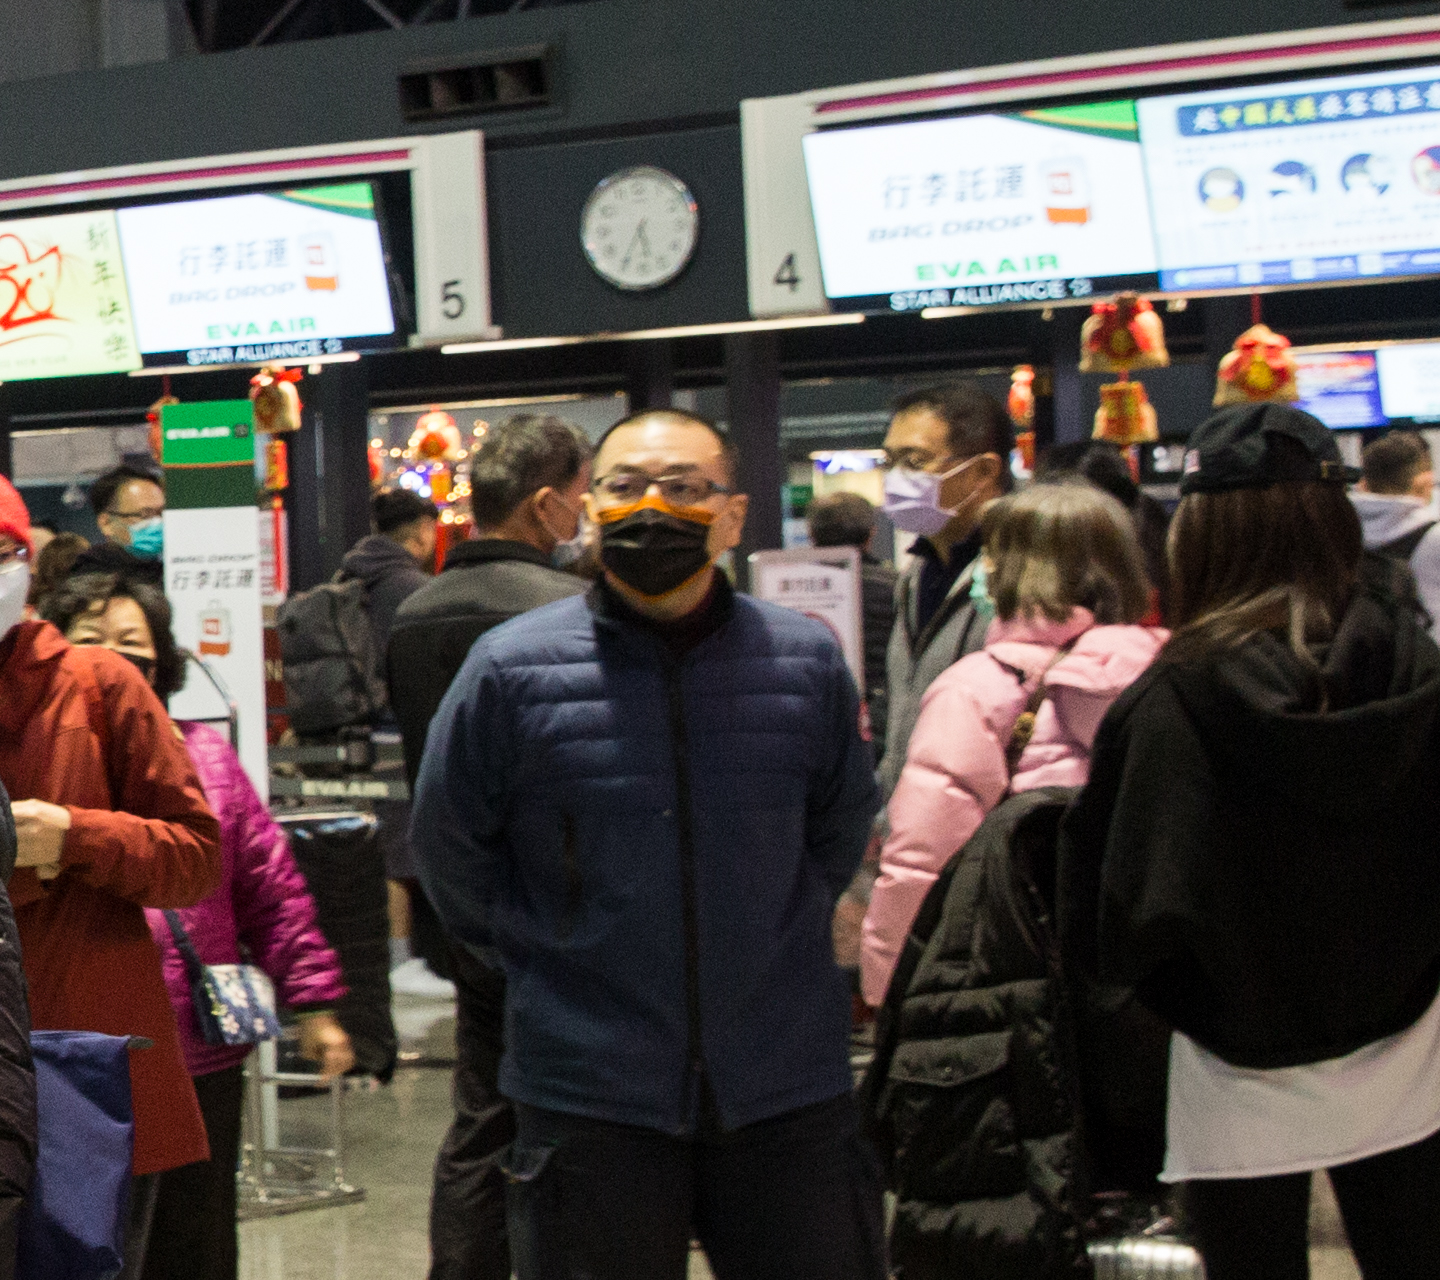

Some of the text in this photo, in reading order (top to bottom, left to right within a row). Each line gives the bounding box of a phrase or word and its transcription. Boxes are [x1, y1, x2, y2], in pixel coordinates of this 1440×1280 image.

[773, 252, 801, 293] 4
[440, 279, 465, 320] 5
[889, 279, 1065, 311] STAR ALLIANCE
